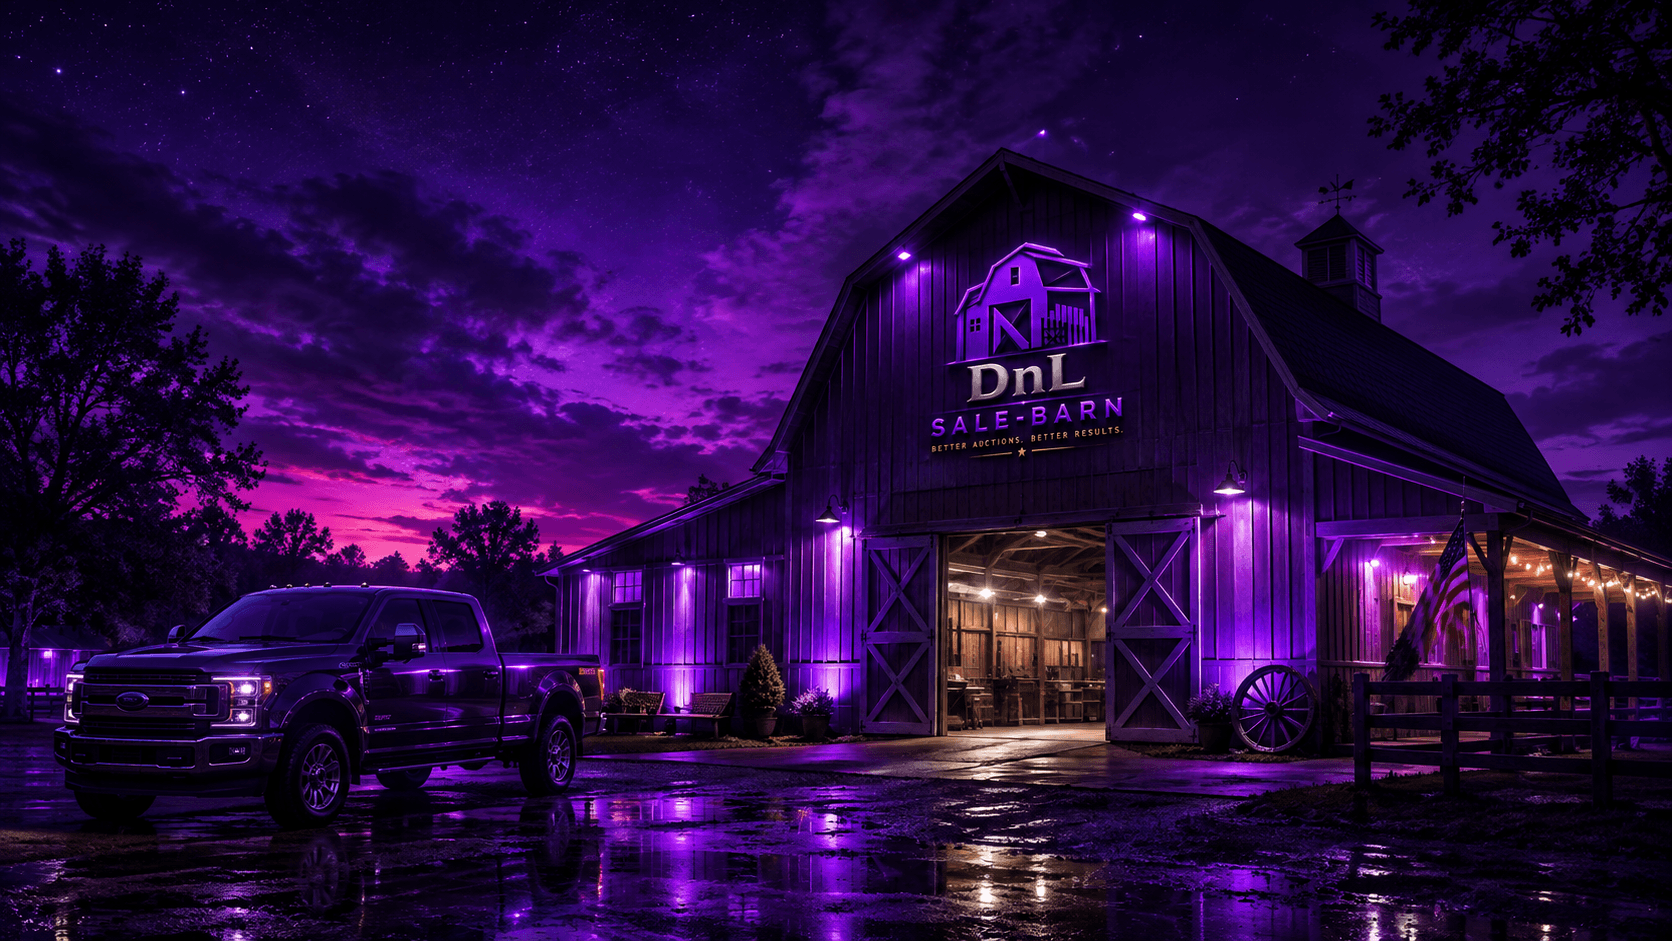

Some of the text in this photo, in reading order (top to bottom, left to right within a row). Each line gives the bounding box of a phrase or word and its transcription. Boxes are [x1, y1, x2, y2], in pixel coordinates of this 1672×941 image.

[967, 353, 1086, 403] DnL
[931, 397, 1123, 437] SALE-BARN
[931, 442, 967, 453] BETTER
[1030, 431, 1069, 443] BETTER
[1074, 426, 1124, 438] RESULTS.
